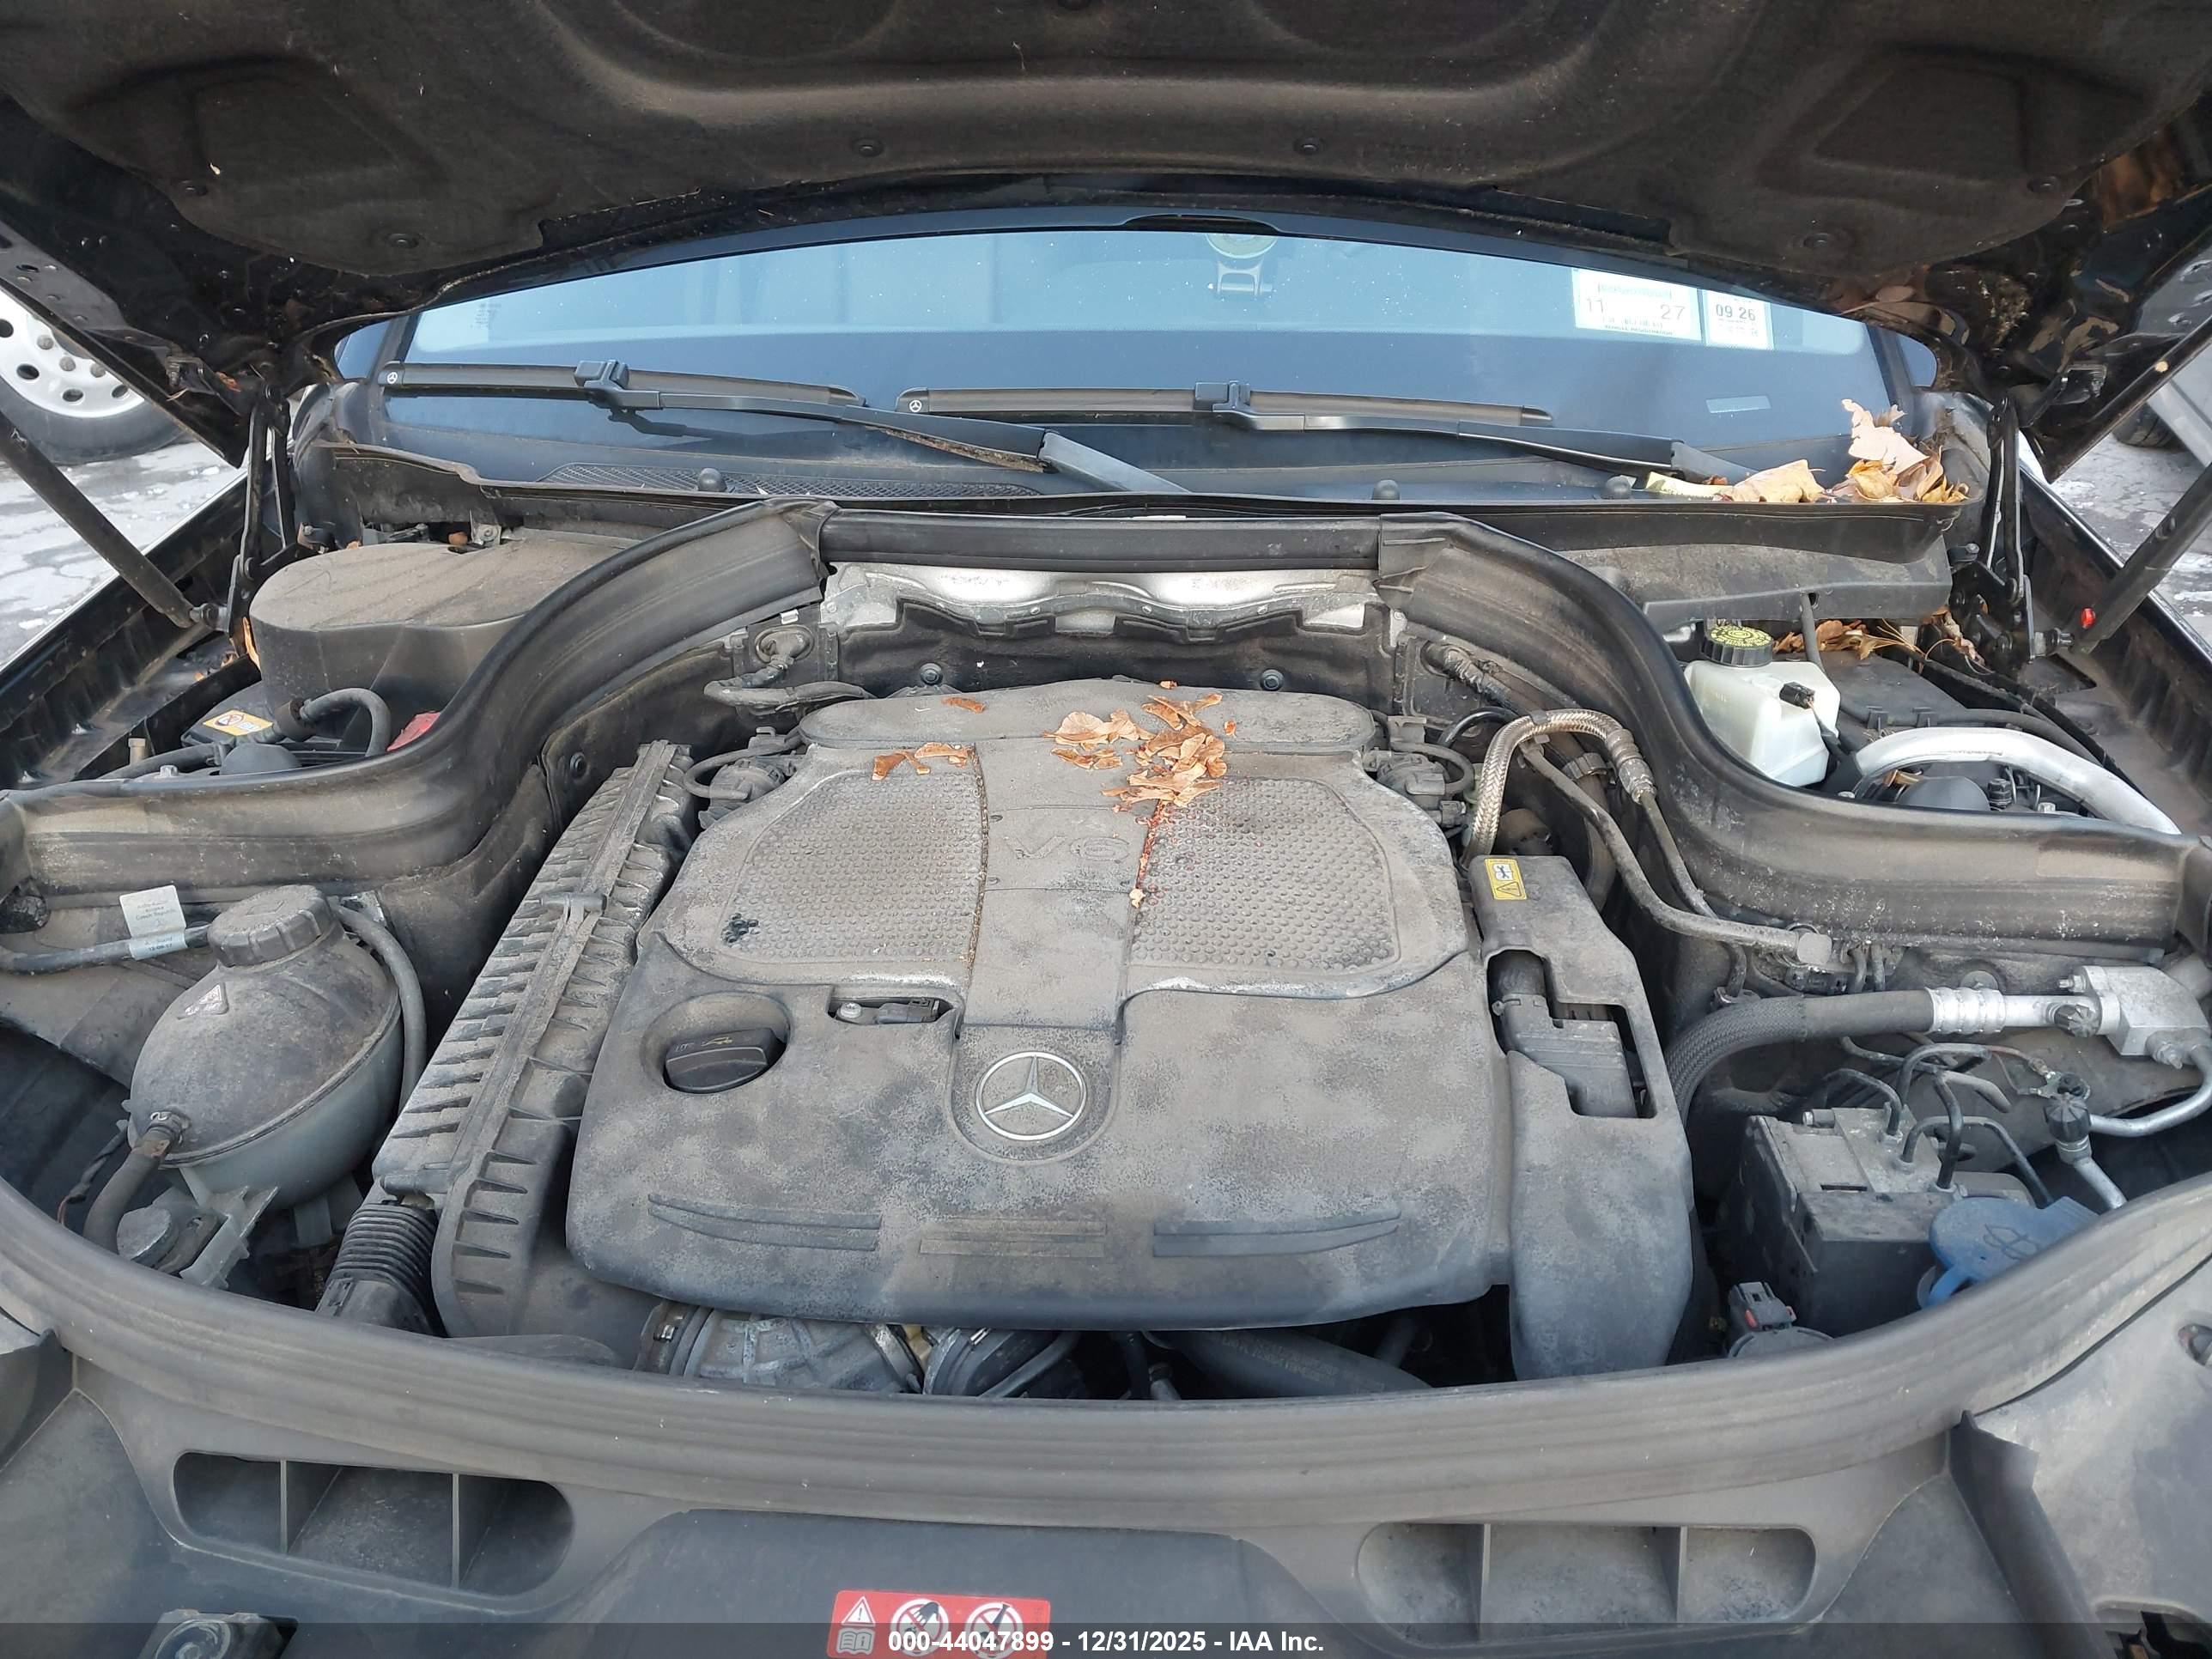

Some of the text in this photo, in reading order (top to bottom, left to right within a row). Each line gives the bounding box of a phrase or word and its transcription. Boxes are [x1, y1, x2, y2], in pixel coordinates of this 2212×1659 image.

[1660, 304, 1686, 320] 27
[1716, 303, 1756, 321] 09 26
[1001, 835, 1130, 864] V6
